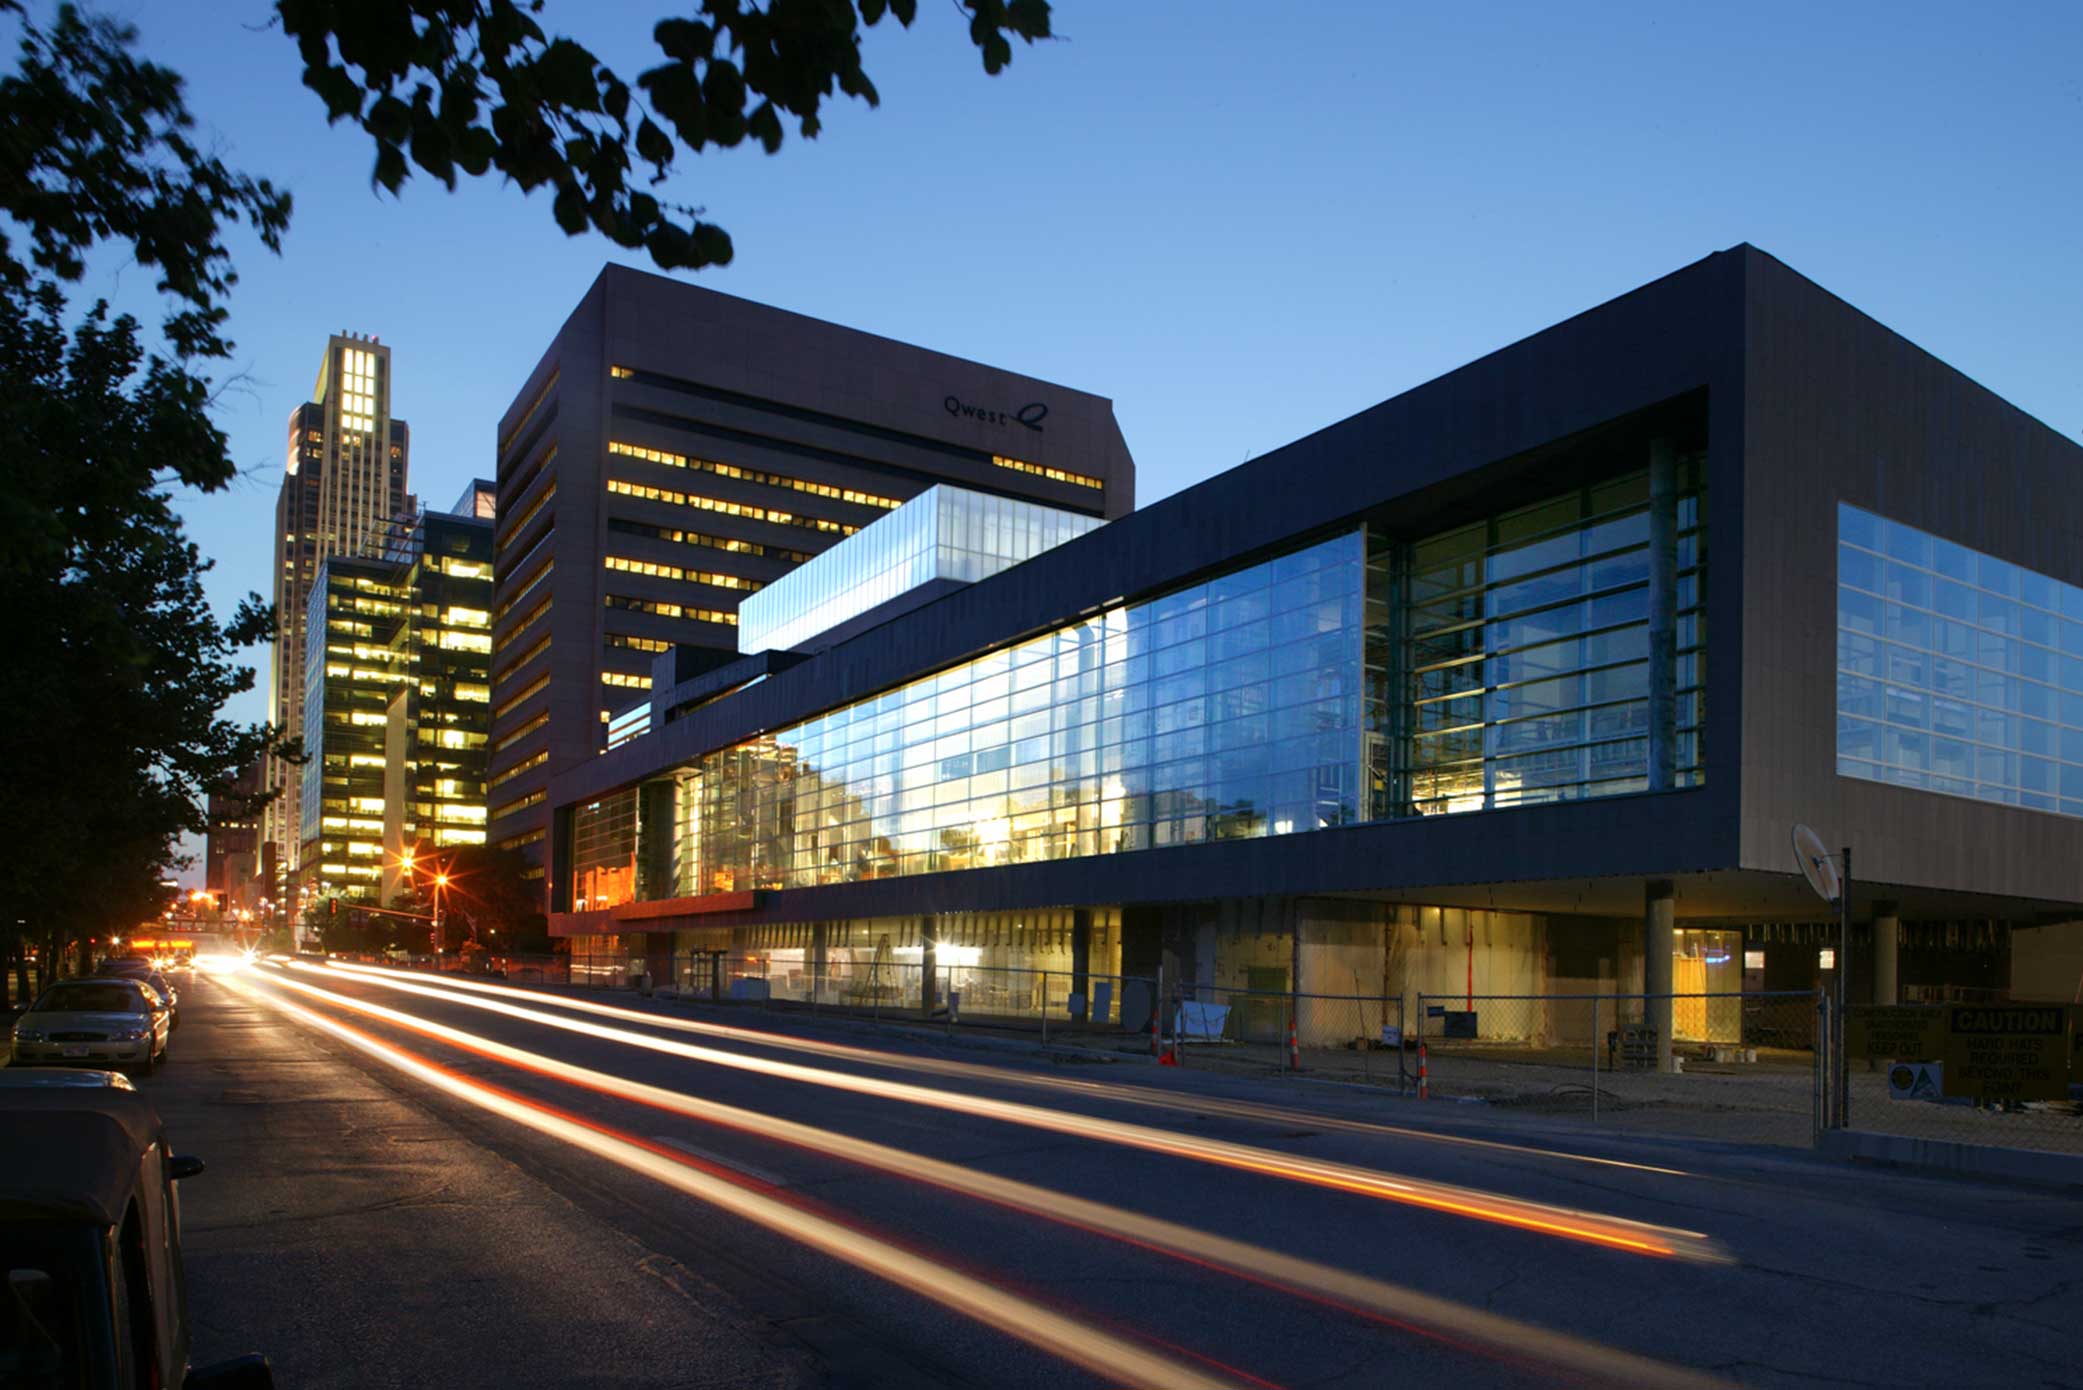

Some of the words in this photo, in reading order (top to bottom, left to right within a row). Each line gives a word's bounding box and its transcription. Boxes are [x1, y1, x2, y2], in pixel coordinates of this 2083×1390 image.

[944, 396, 1008, 426] Qwest
[1957, 1011, 2058, 1031] CAUTION
[1867, 1041, 1897, 1055] KEEP
[1899, 1041, 1923, 1055] OUT
[1967, 1037, 2002, 1050] HAND
[2009, 1037, 2043, 1050] HATS
[1970, 1052, 2039, 1065] REQUIRED
[1958, 1066, 2015, 1080] BEYOND
[2018, 1067, 2049, 1080] THIS
